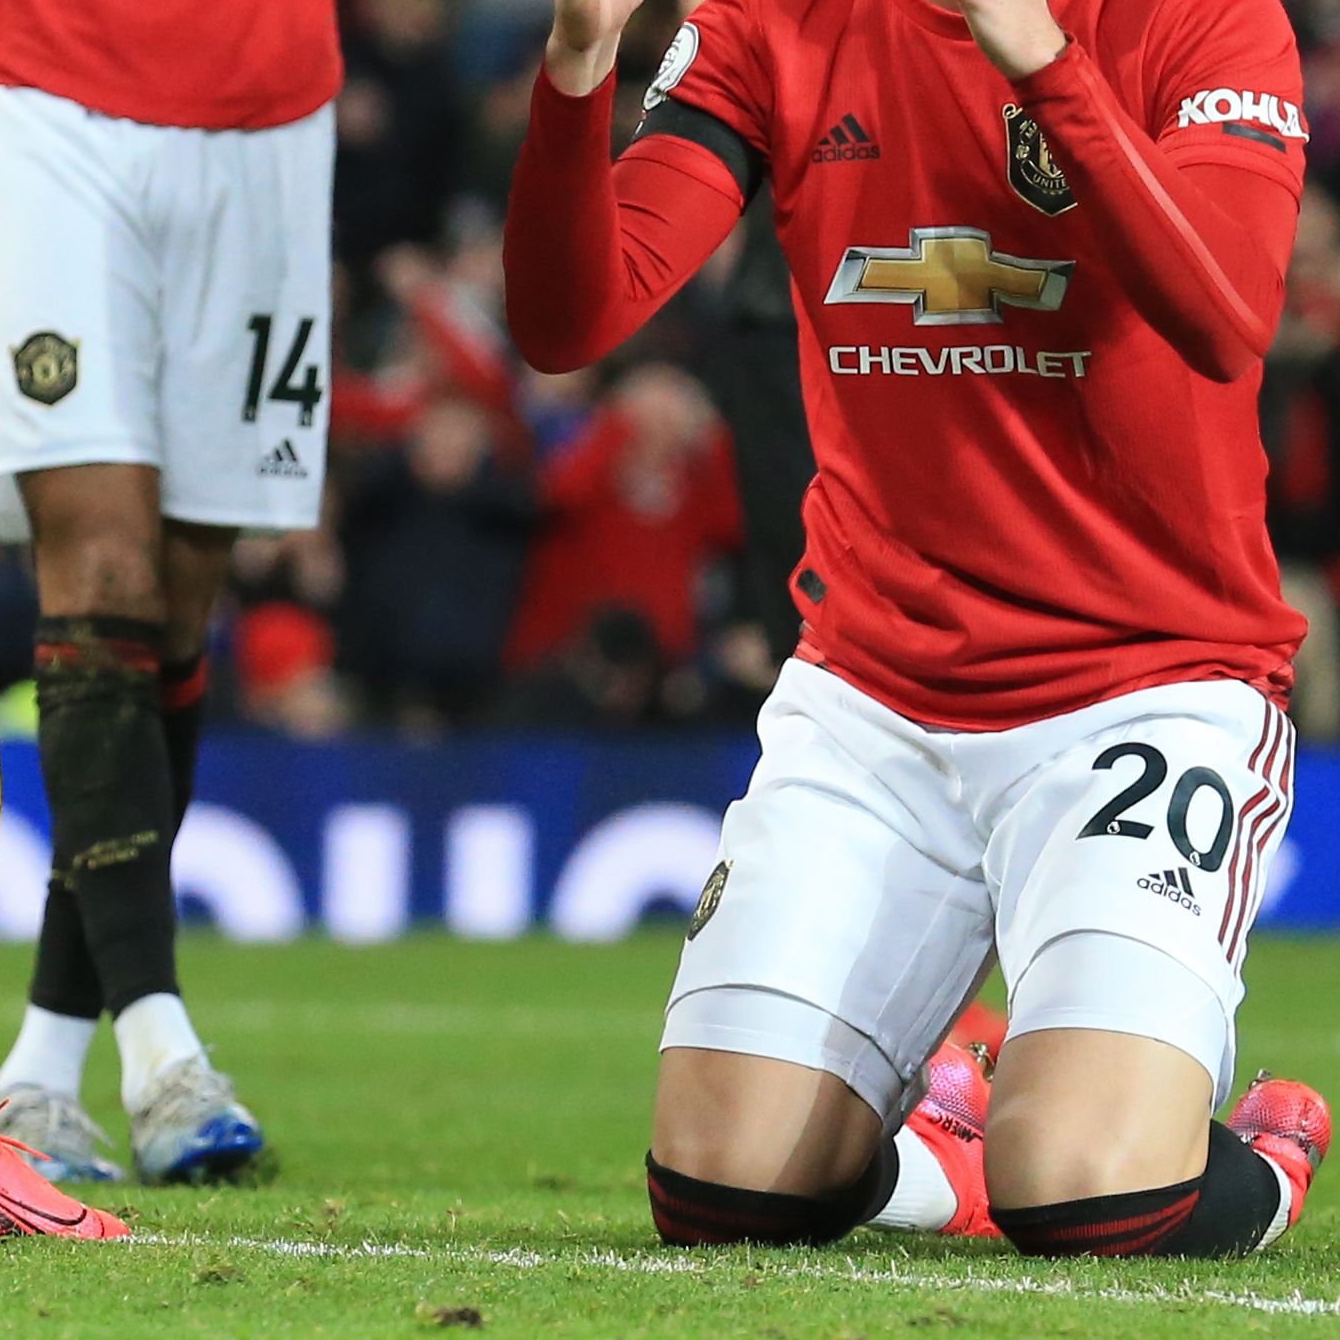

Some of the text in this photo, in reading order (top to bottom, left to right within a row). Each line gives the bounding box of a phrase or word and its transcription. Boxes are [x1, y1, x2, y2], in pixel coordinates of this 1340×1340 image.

[1178, 88, 1310, 143] KOHL
[811, 142, 880, 163] adidas
[1032, 172, 1068, 189] UNITE
[241, 313, 323, 427] 14
[829, 345, 1092, 378] CHEVROLET
[1075, 742, 1234, 872] 20
[1136, 876, 1202, 917] adidas
